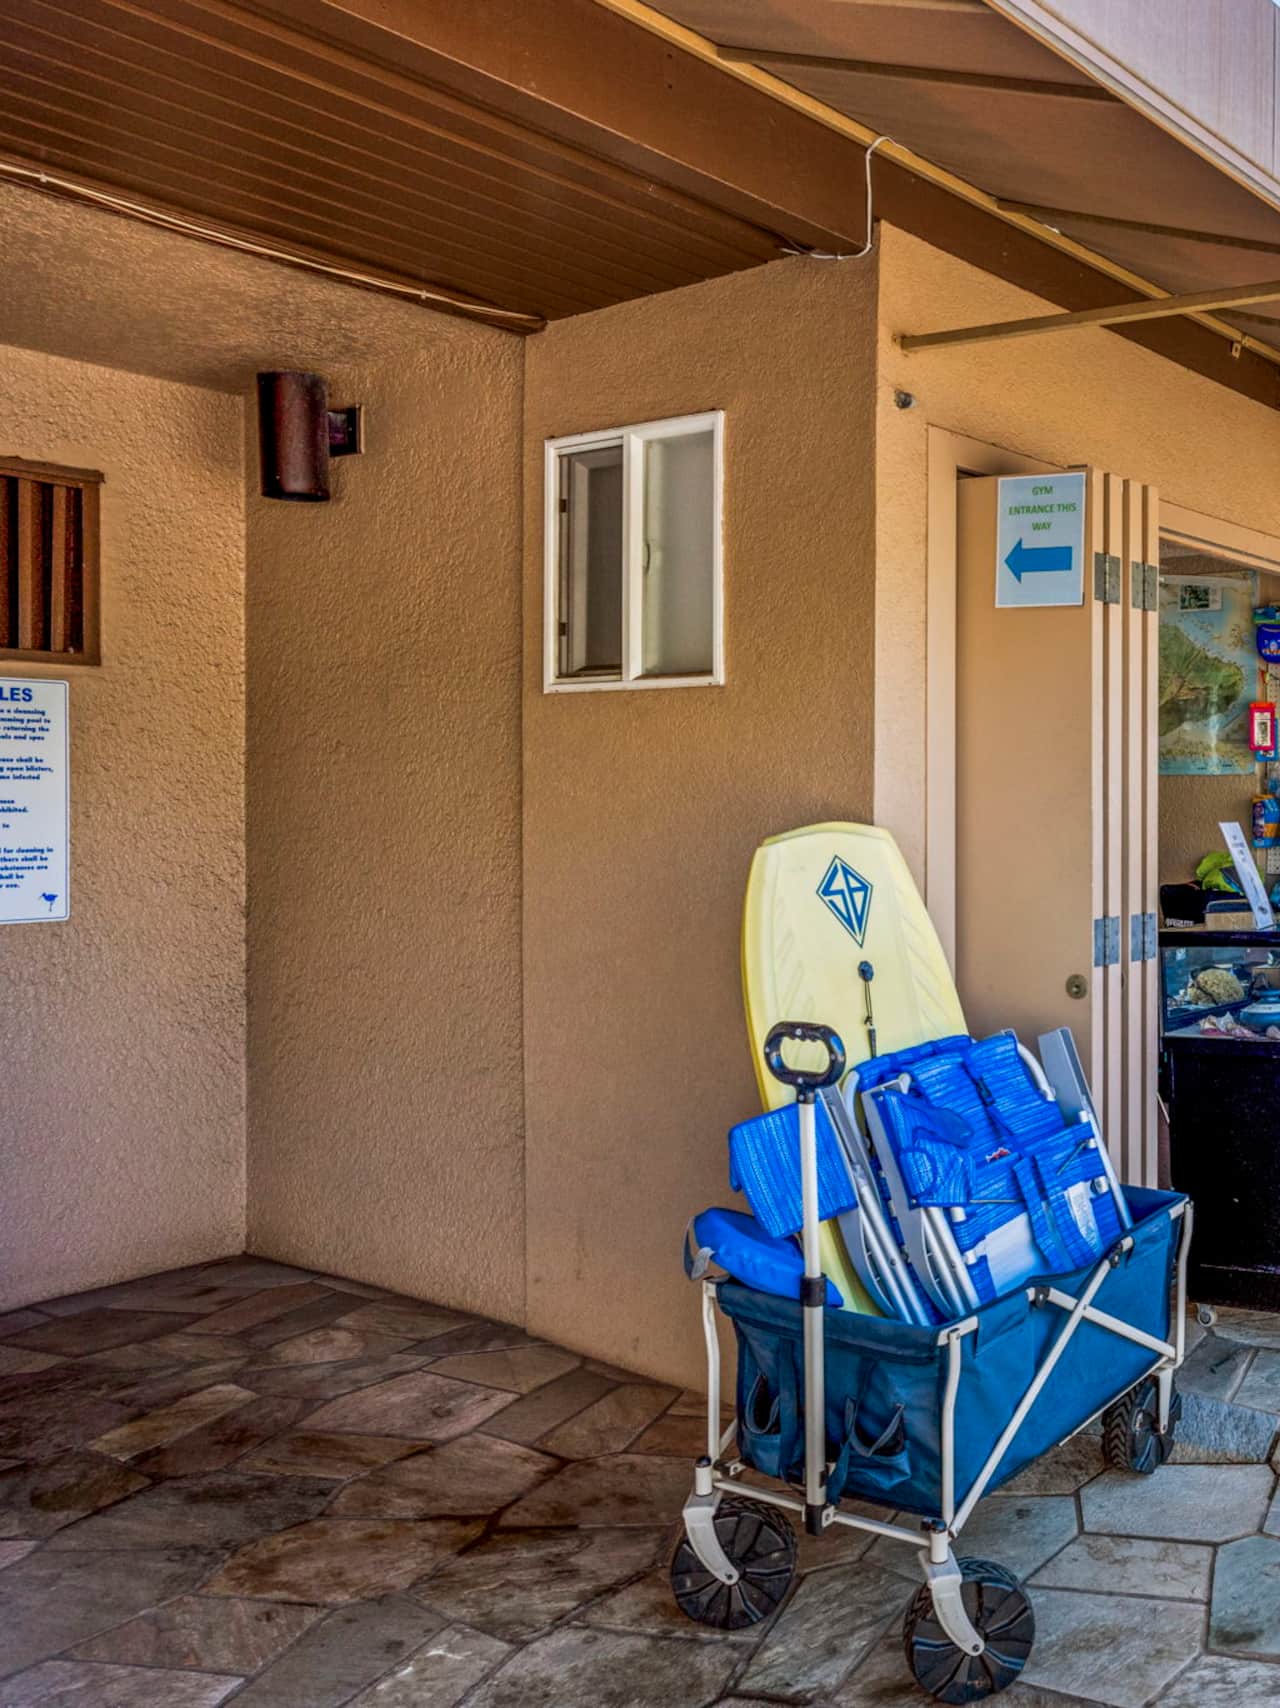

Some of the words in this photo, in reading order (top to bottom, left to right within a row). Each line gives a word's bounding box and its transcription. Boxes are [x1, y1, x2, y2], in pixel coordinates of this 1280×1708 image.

[1031, 486, 1053, 496] GYM
[1008, 503, 1054, 516] ENTRANCE
[1056, 502, 1077, 513] THIS
[1031, 522, 1052, 531] WAY
